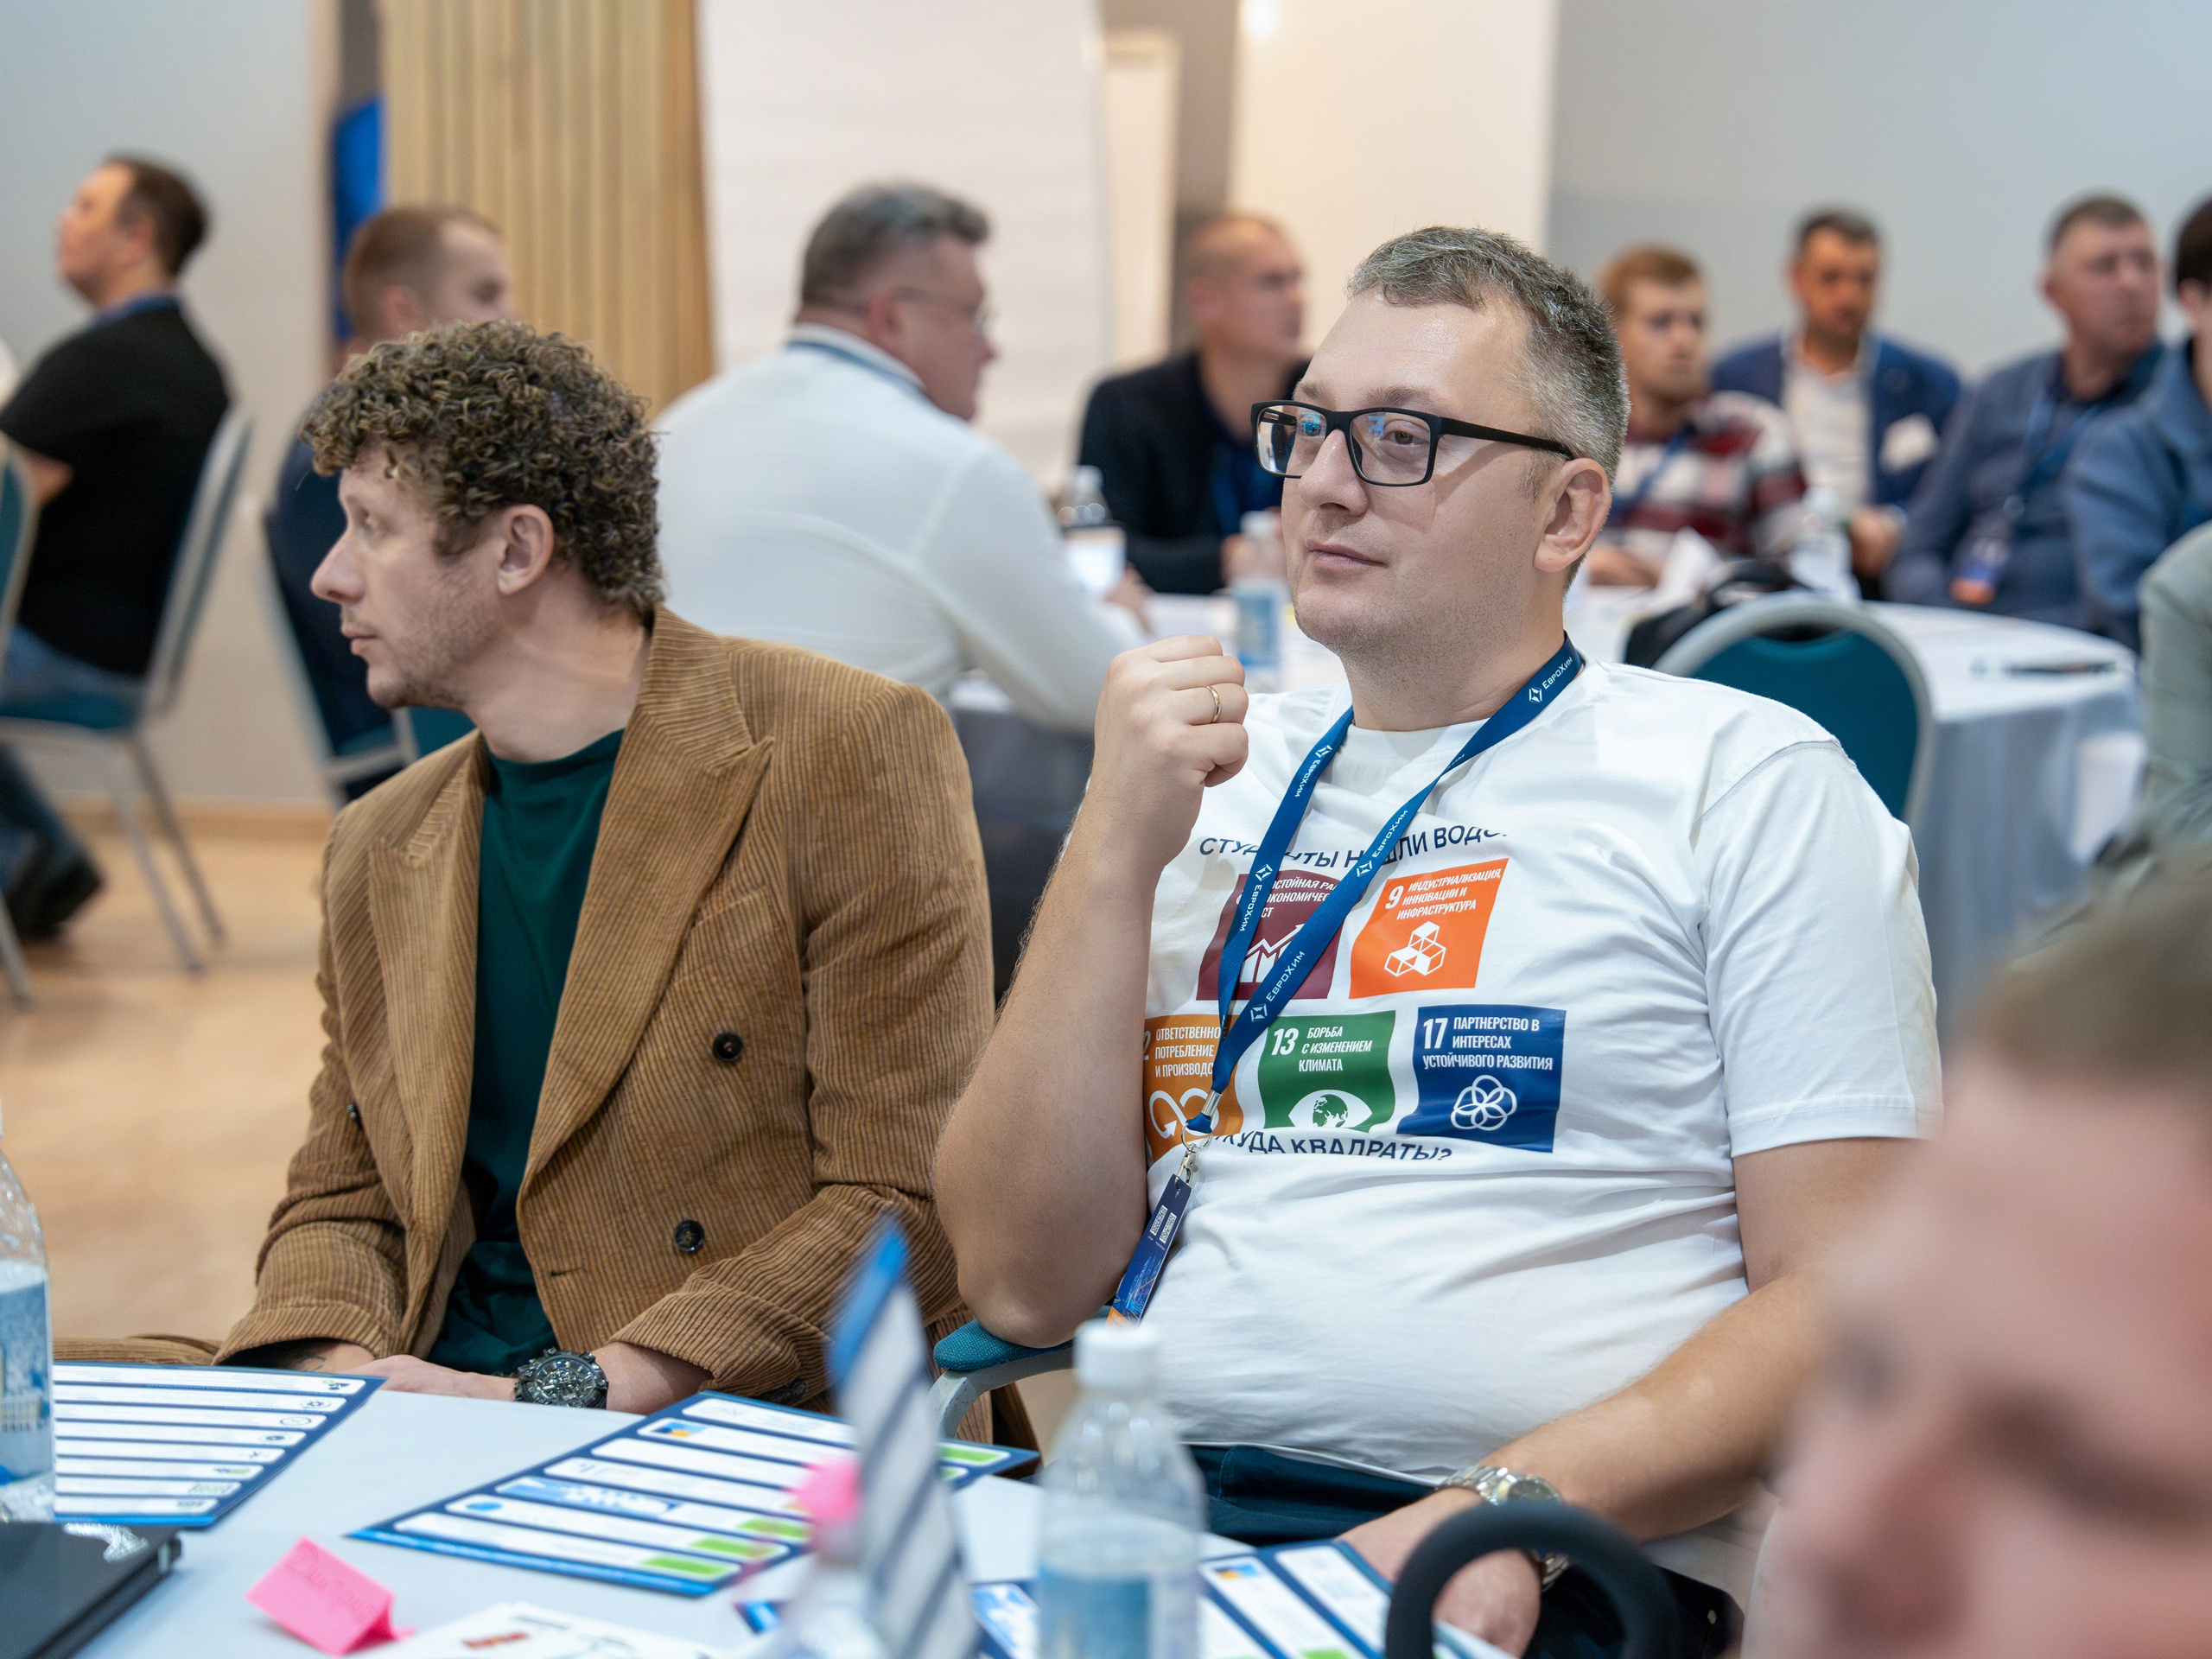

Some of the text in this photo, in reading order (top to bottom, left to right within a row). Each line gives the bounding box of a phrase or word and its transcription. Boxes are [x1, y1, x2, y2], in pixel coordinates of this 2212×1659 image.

[1344, 831, 1428, 868] НШЛИ
[1319, 881, 1338, 892] РА
[1385, 868, 1502, 910] 9 ИНДУСТРИАЛИЗАЦИЯ,
[1402, 886, 1468, 906] ИННОВАЦИИ И
[1261, 906, 1274, 918] СТ
[1396, 899, 1477, 921] ИНФРАСТРУКТУРА
[1271, 1026, 1343, 1056] 13 БОРЬБА
[1422, 1016, 1540, 1050] 17 ПАРТНЕРСТВО В
[1301, 1039, 1373, 1054] С ИЗМЕНЕНИЕМ
[1452, 1035, 1512, 1050] ИНТЕРЕСАХ
[1154, 1044, 1215, 1059] ПОТРЕБЛЕНИЕ
[1154, 1062, 1214, 1077] И ПРОИЗВОДС
[1298, 1058, 1344, 1072] КЛИМАТА
[1422, 1052, 1554, 1071] УСТОЙЧИВОГО РАЗВИТИЯ
